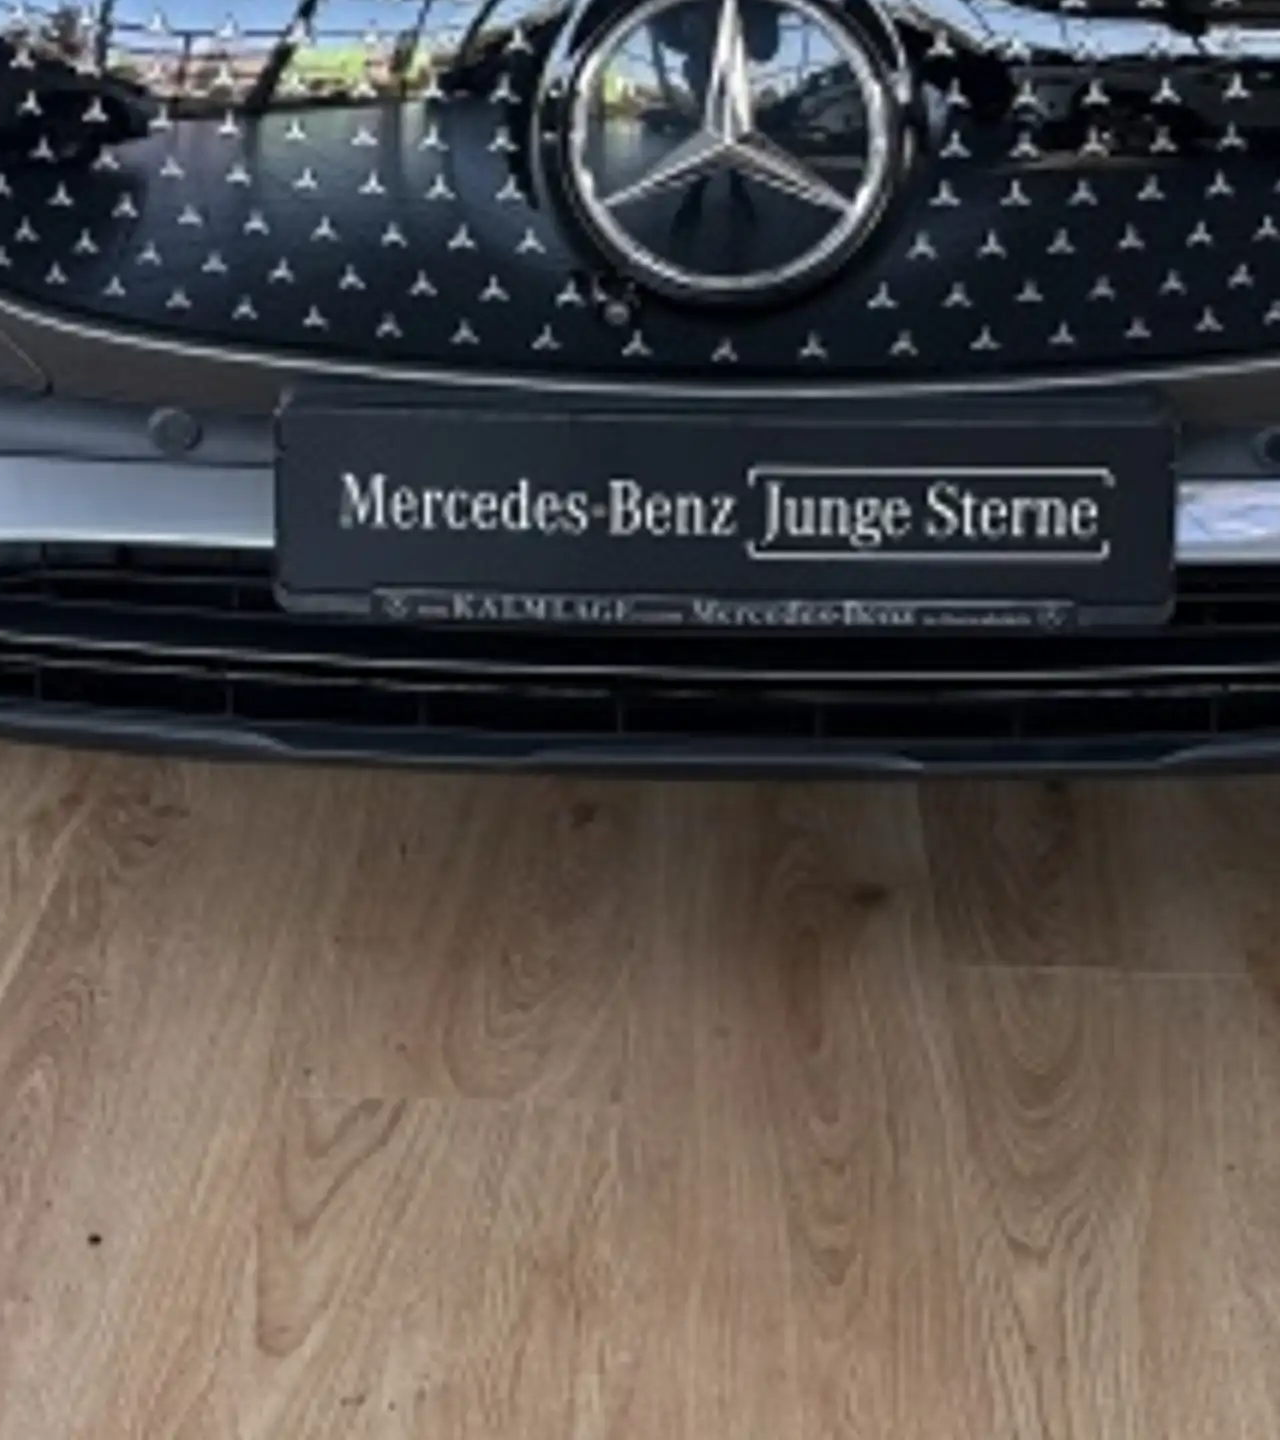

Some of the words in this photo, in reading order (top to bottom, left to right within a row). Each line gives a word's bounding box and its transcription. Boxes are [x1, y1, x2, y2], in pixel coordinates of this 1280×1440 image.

[339, 472, 737, 536] Mercedes-Benz
[762, 482, 912, 547] Junge
[925, 482, 1099, 538] Sterne
